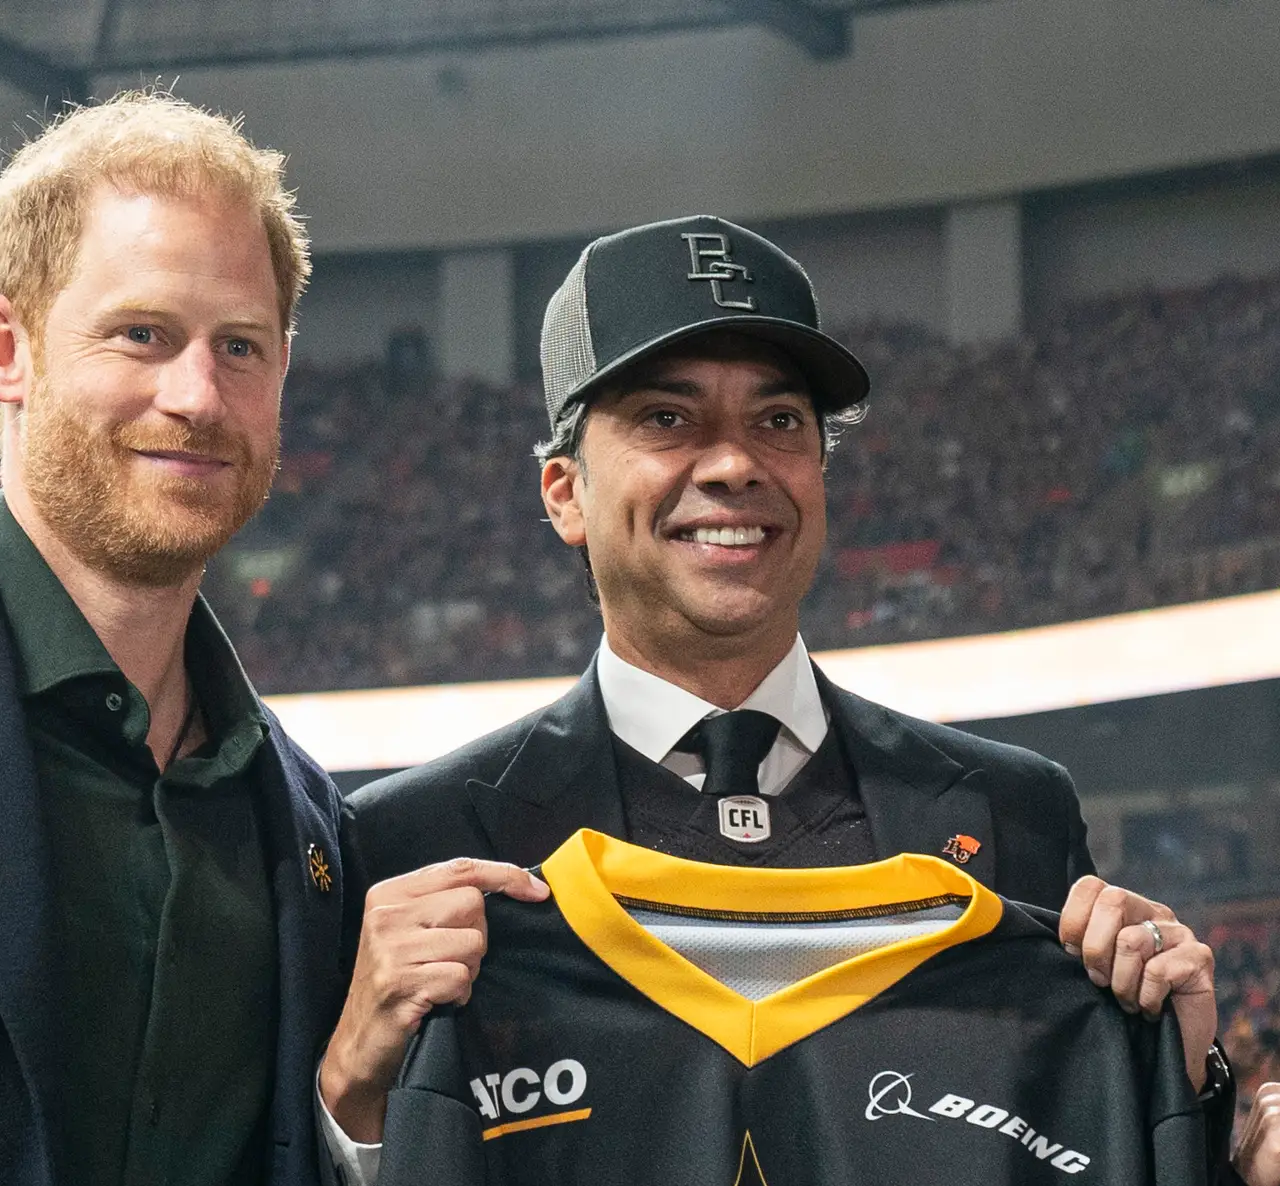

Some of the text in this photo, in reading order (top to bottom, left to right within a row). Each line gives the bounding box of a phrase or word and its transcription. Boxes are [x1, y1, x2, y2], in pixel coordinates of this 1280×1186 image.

[681, 233, 755, 311] BC
[728, 808, 764, 829] CFL
[928, 1093, 1091, 1174] BOEING
